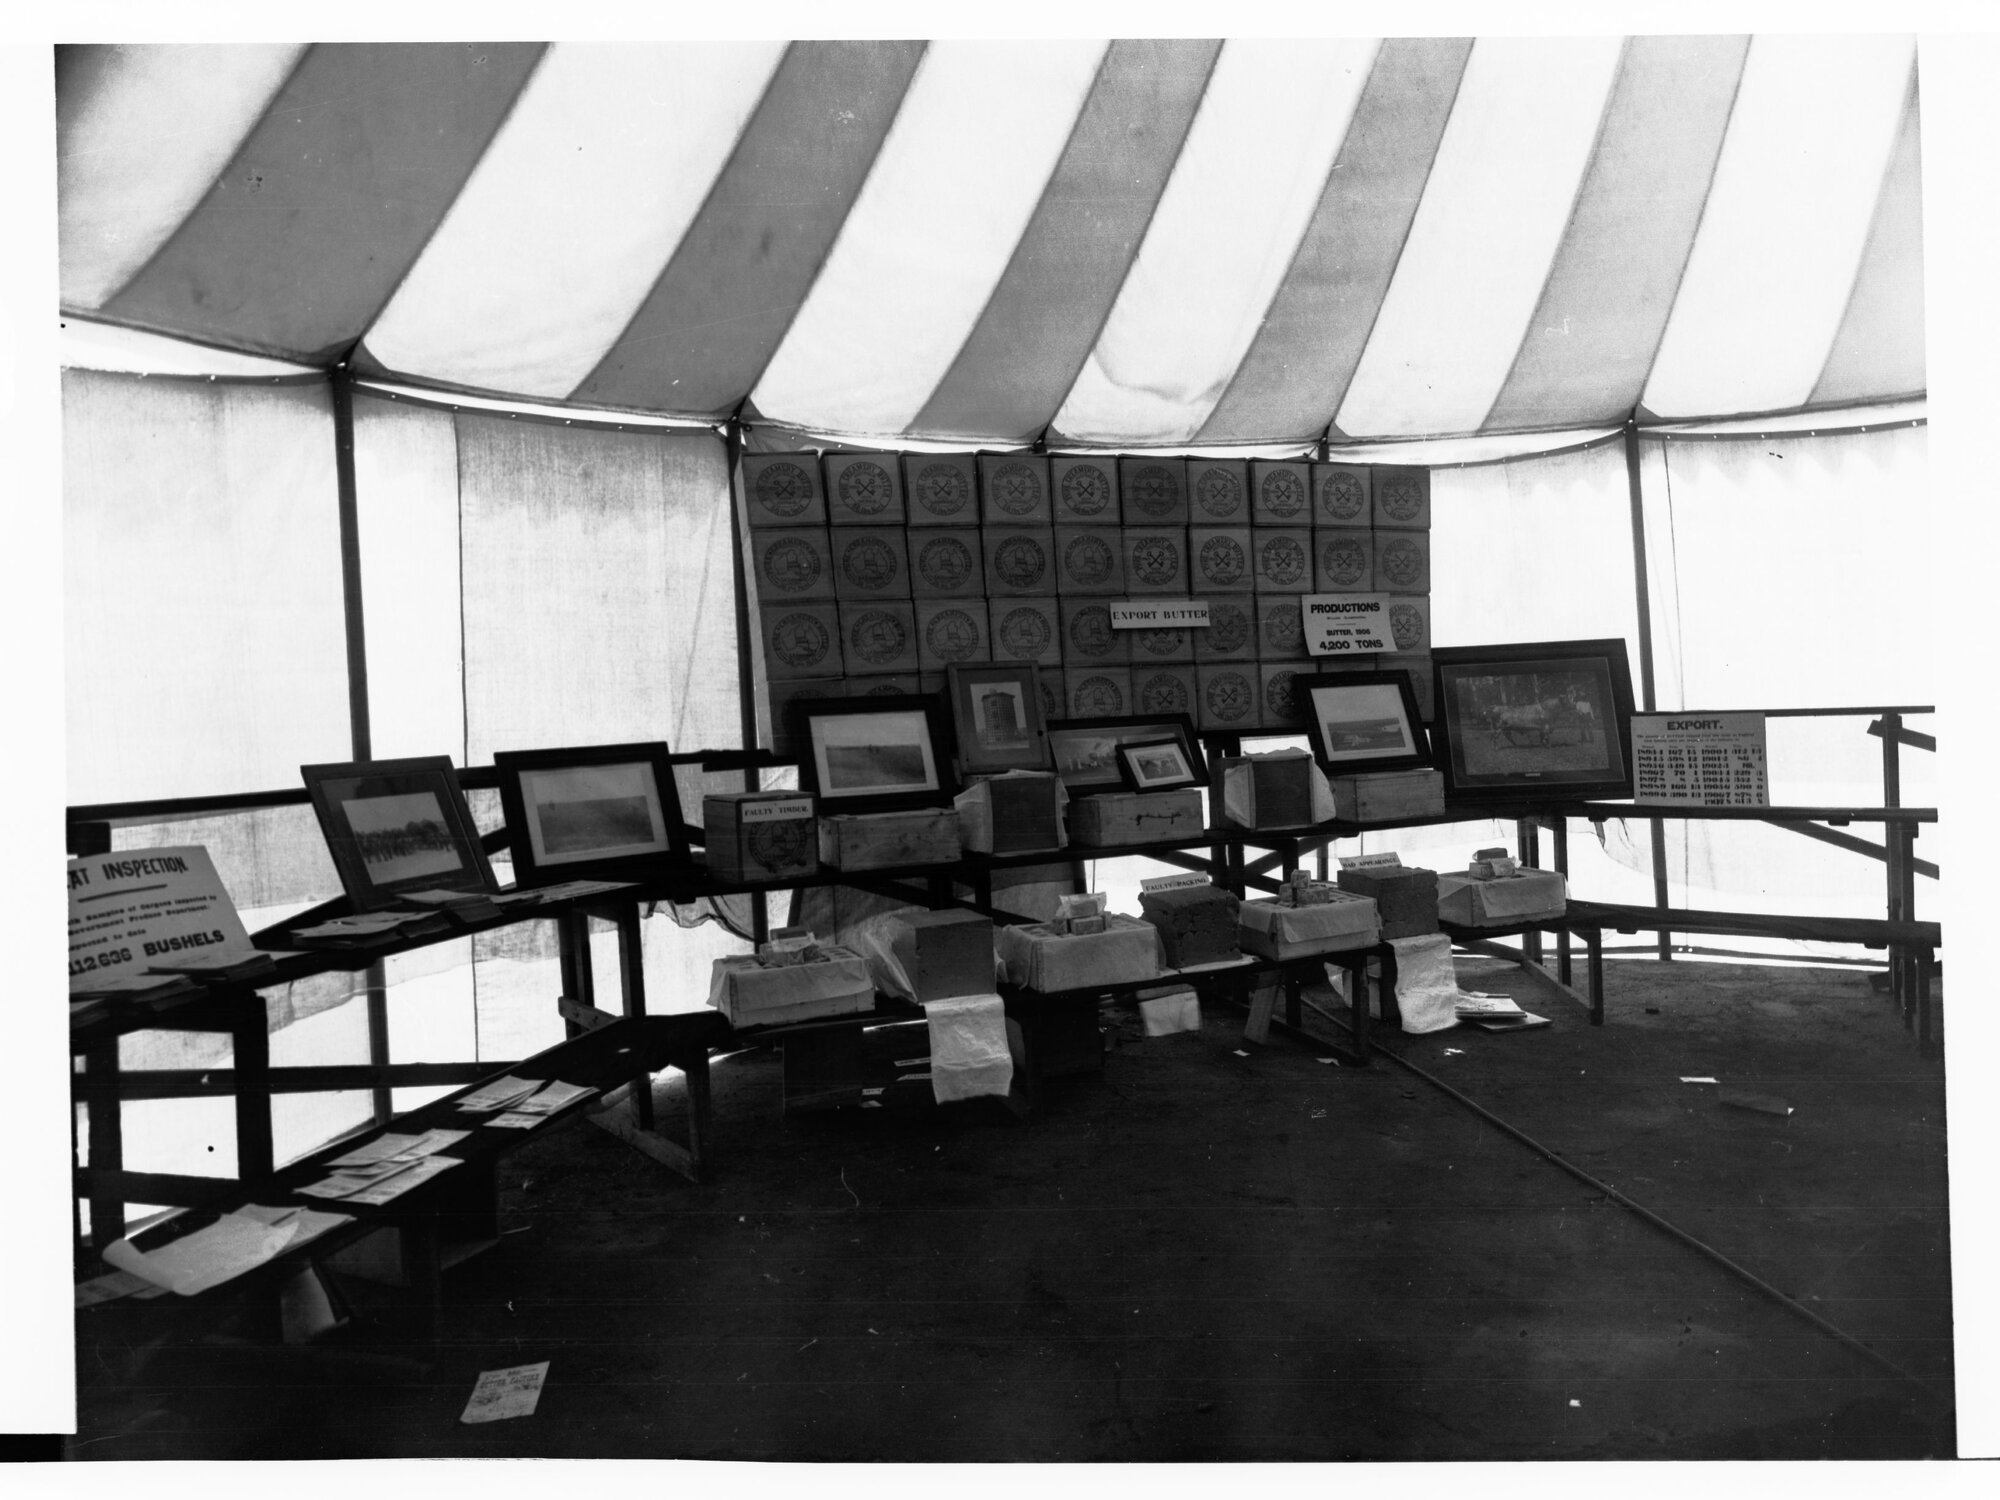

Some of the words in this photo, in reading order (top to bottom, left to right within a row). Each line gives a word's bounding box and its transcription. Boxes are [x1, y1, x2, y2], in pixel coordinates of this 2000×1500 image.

[1310, 602, 1380, 614] PRODUCTIONS
[1113, 611, 1157, 620] EXPORT
[1163, 609, 1208, 619] BUTTER
[1319, 640, 1350, 651] 4,200
[1355, 639, 1383, 649] TONS
[1667, 720, 1724, 731] EXPORT.
[744, 807, 773, 816] FAULTY
[67, 867, 90, 890] AT
[1146, 882, 1173, 892] FAULTY
[143, 929, 225, 957] BUSHELS
